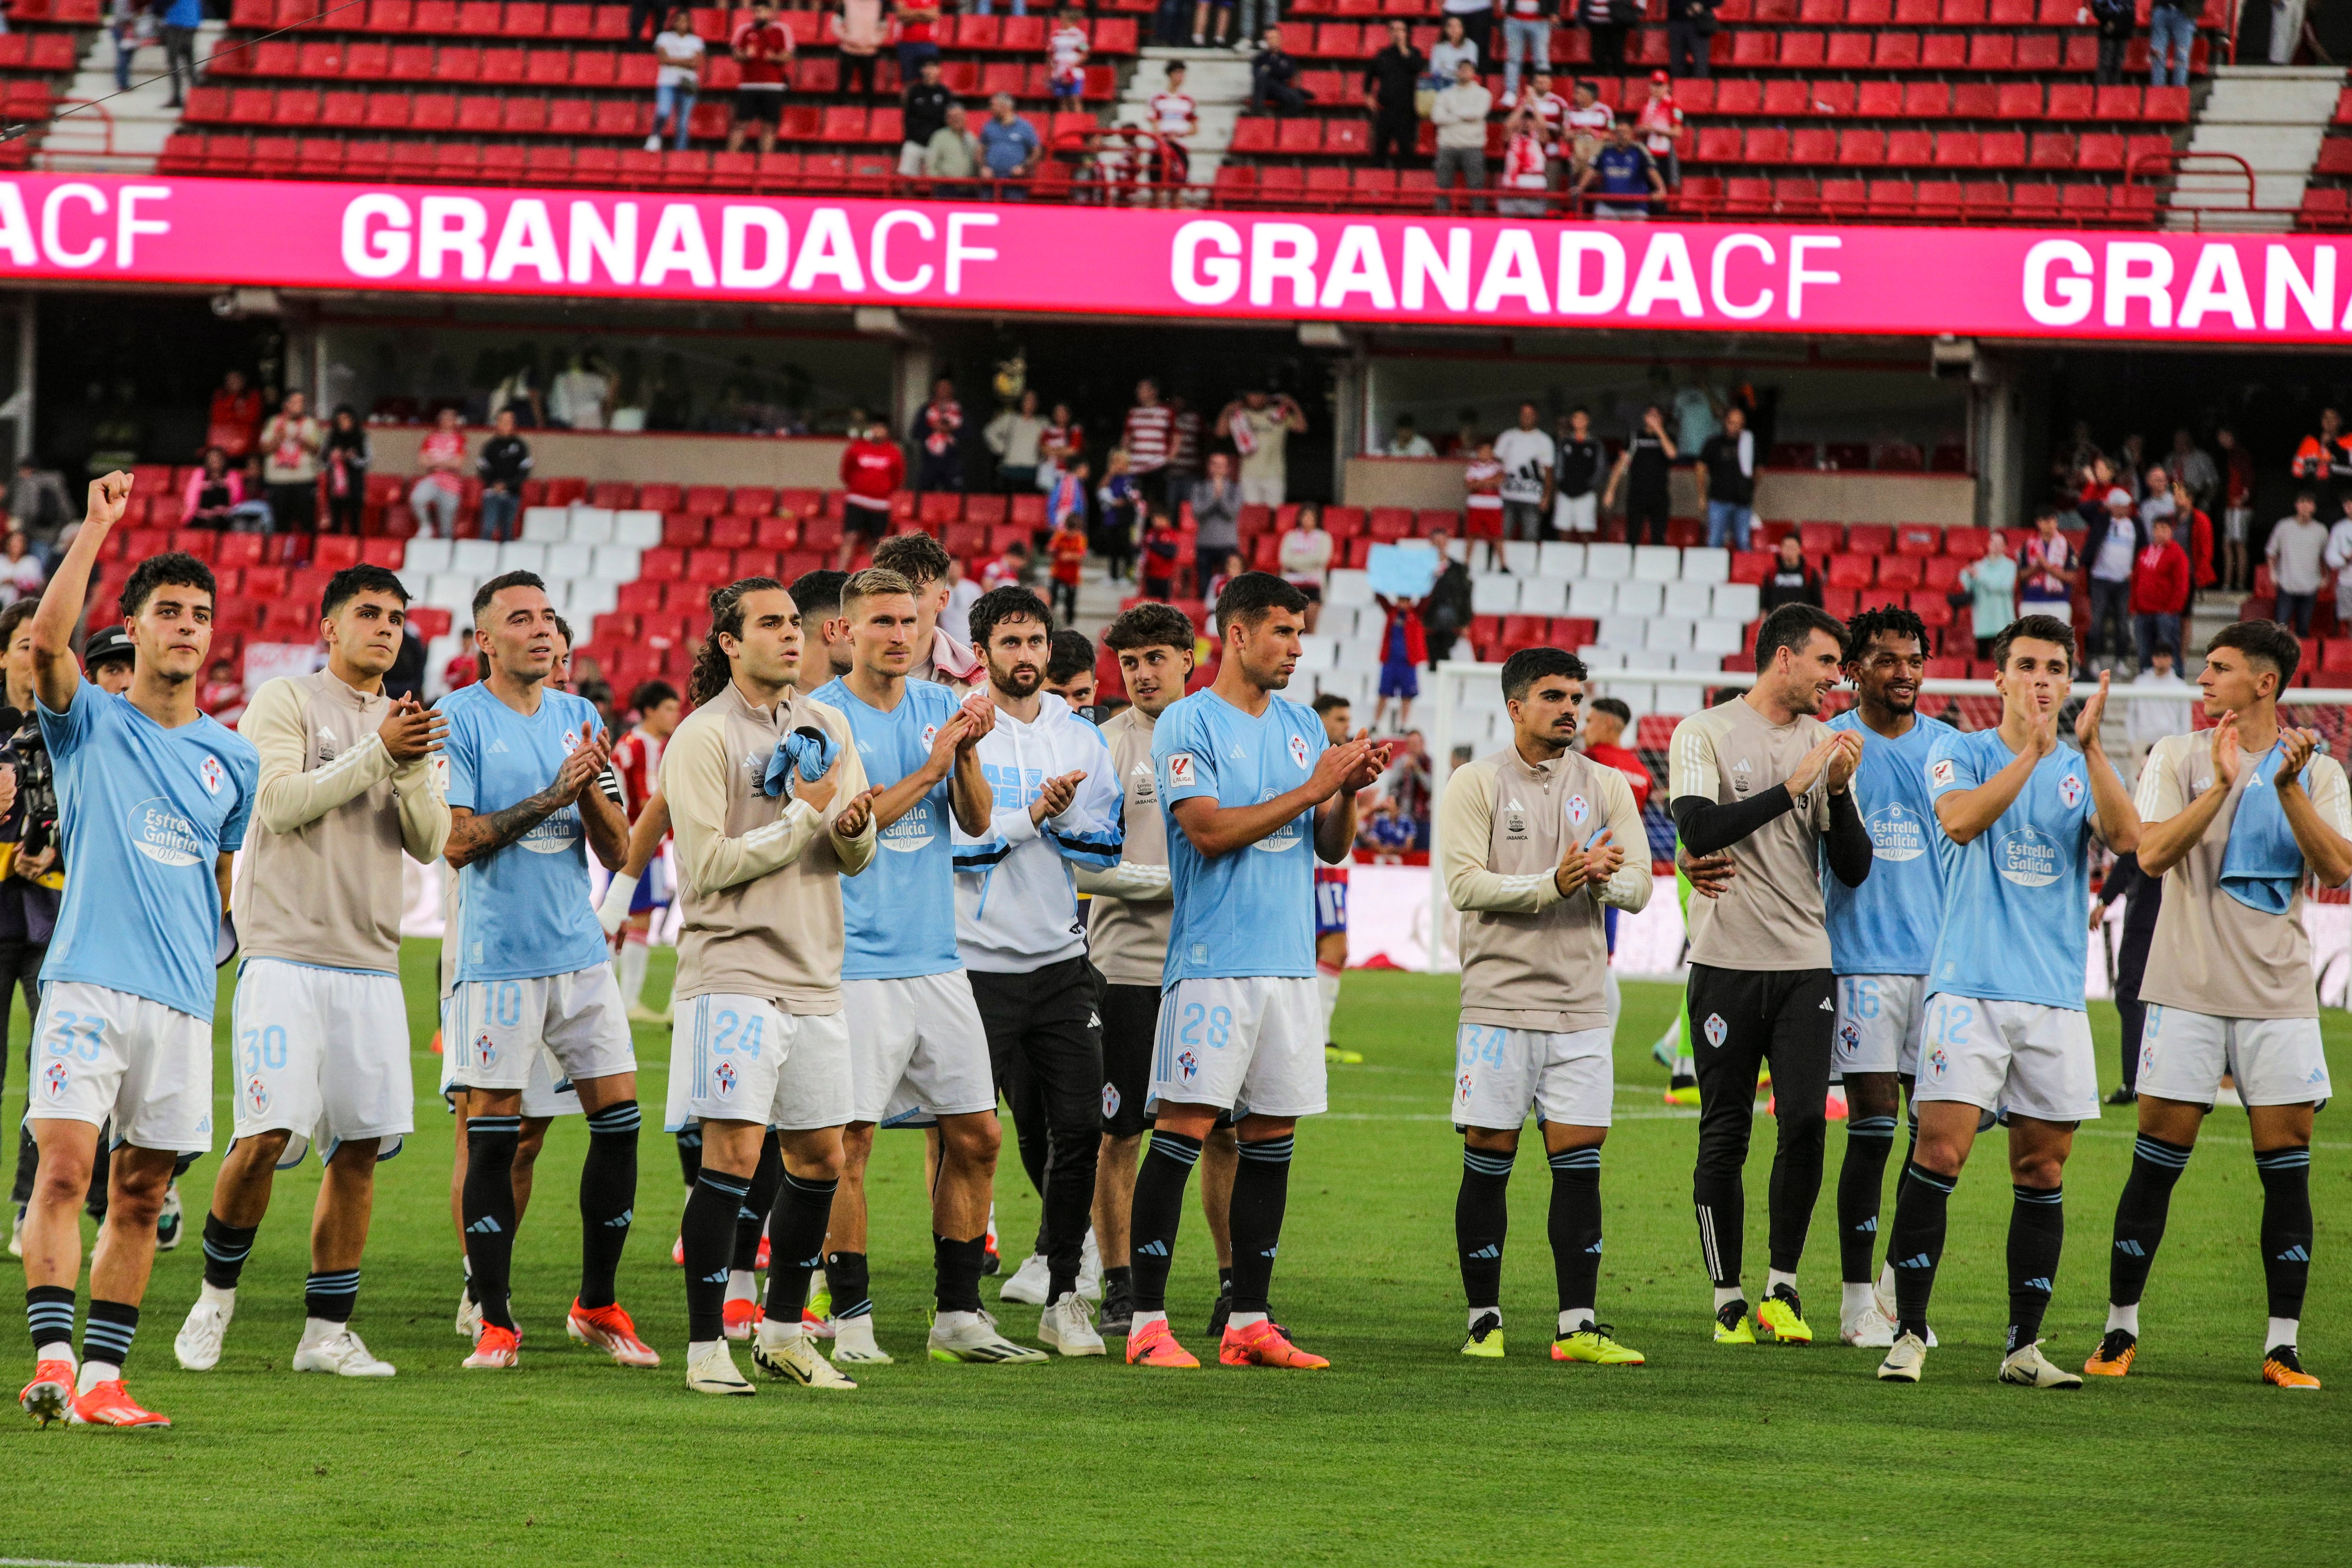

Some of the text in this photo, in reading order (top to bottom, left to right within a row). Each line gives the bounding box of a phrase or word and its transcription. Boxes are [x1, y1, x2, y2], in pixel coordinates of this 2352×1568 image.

[342, 193, 999, 295] GRANADACF
[1171, 220, 1842, 319] GRANADACF
[2023, 239, 2352, 330] GRAN
[1797, 794, 1809, 809] 13
[143, 825, 198, 853] Galicia
[885, 821, 927, 837] Galicia
[1872, 820, 1920, 834] Estrella
[1874, 833, 1918, 847] Galicia
[2006, 841, 2055, 858] Estrella
[2008, 855, 2052, 873] Galicia
[481, 981, 521, 1026] 10
[1844, 979, 1879, 1019] 16
[48, 1010, 105, 1061] 33
[713, 1010, 764, 1060] 24
[1180, 1003, 1232, 1048] 28
[1938, 1005, 1972, 1044] 12
[242, 1025, 286, 1075] 30
[1462, 1024, 1507, 1069] 34
